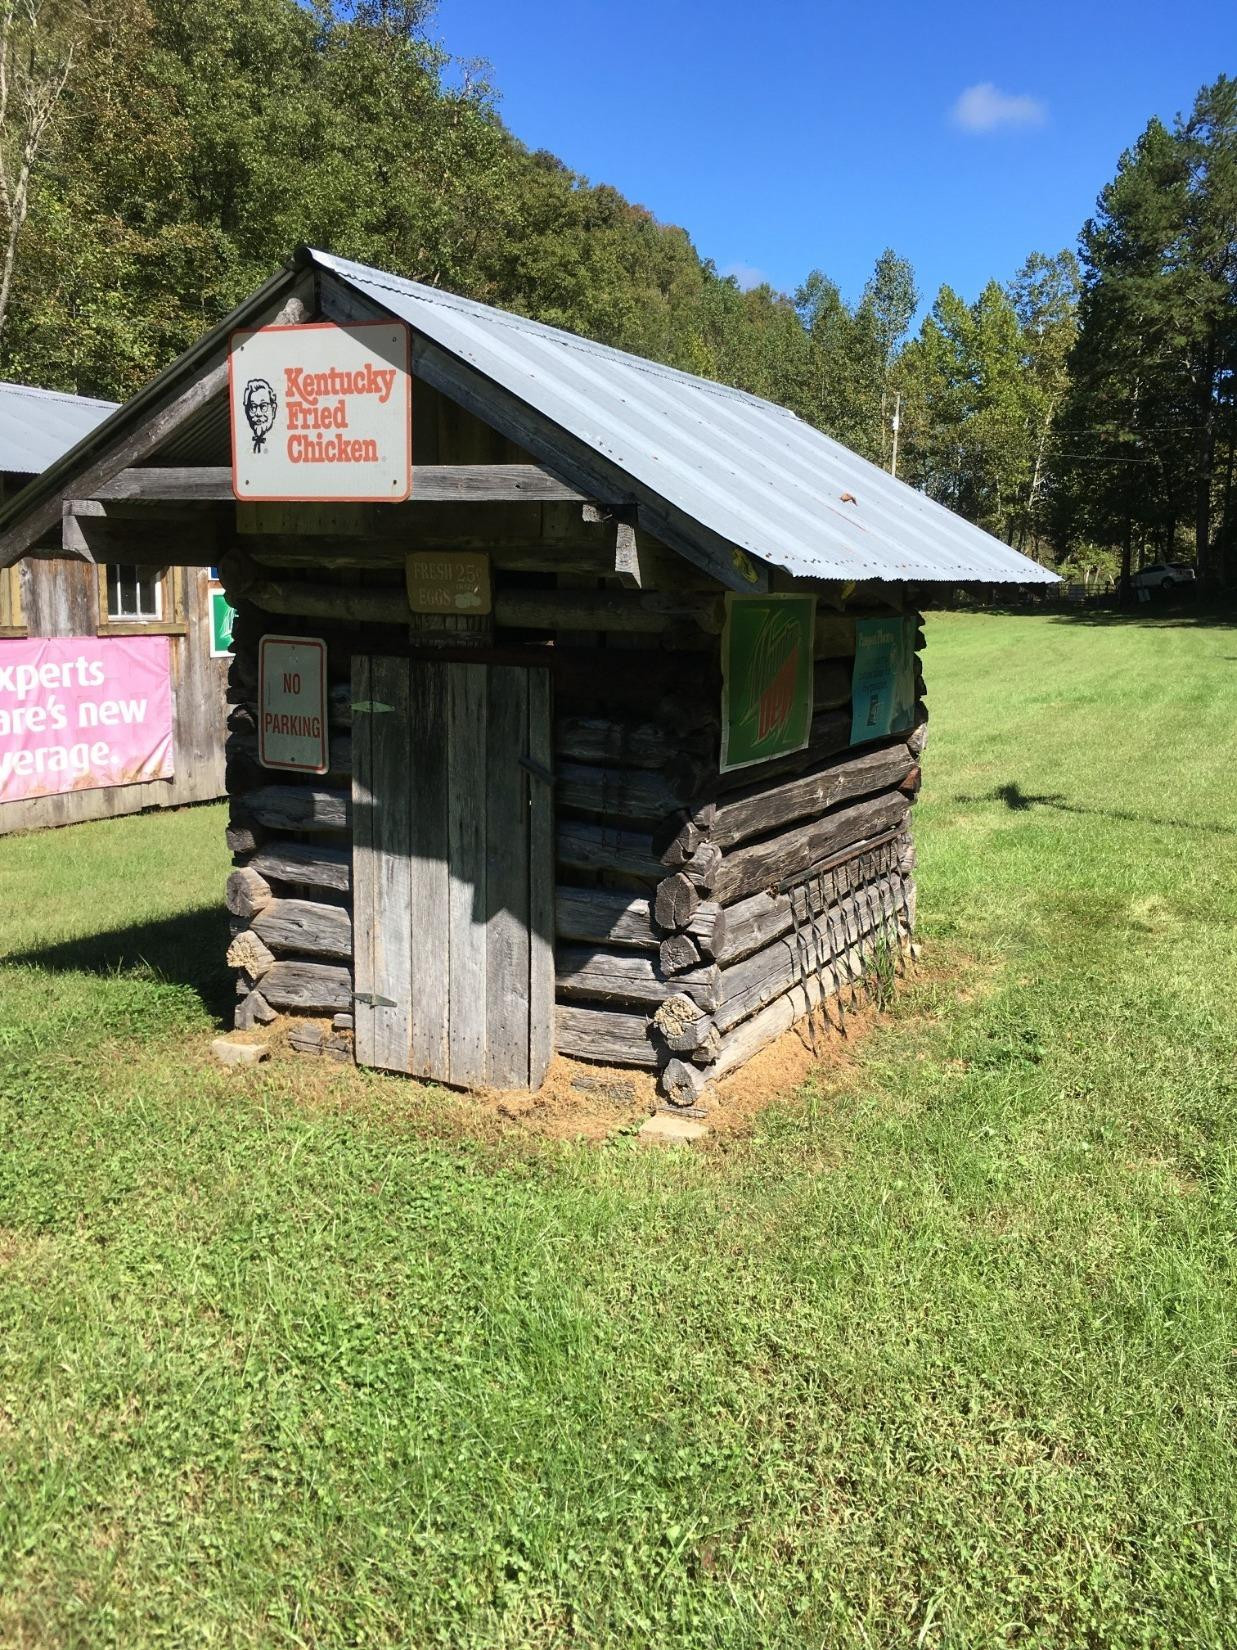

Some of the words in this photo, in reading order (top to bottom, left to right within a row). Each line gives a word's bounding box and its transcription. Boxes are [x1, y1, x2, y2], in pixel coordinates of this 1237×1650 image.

[284, 363, 397, 405] Kentucky
[286, 399, 349, 431] Fried
[287, 432, 379, 464] Chicken
[414, 561, 453, 580] FRESH
[419, 587, 452, 607] EGGS
[0, 655, 105, 701] xperts
[283, 673, 301, 695] NO
[78, 698, 148, 728] new
[265, 712, 321, 739] PARKING
